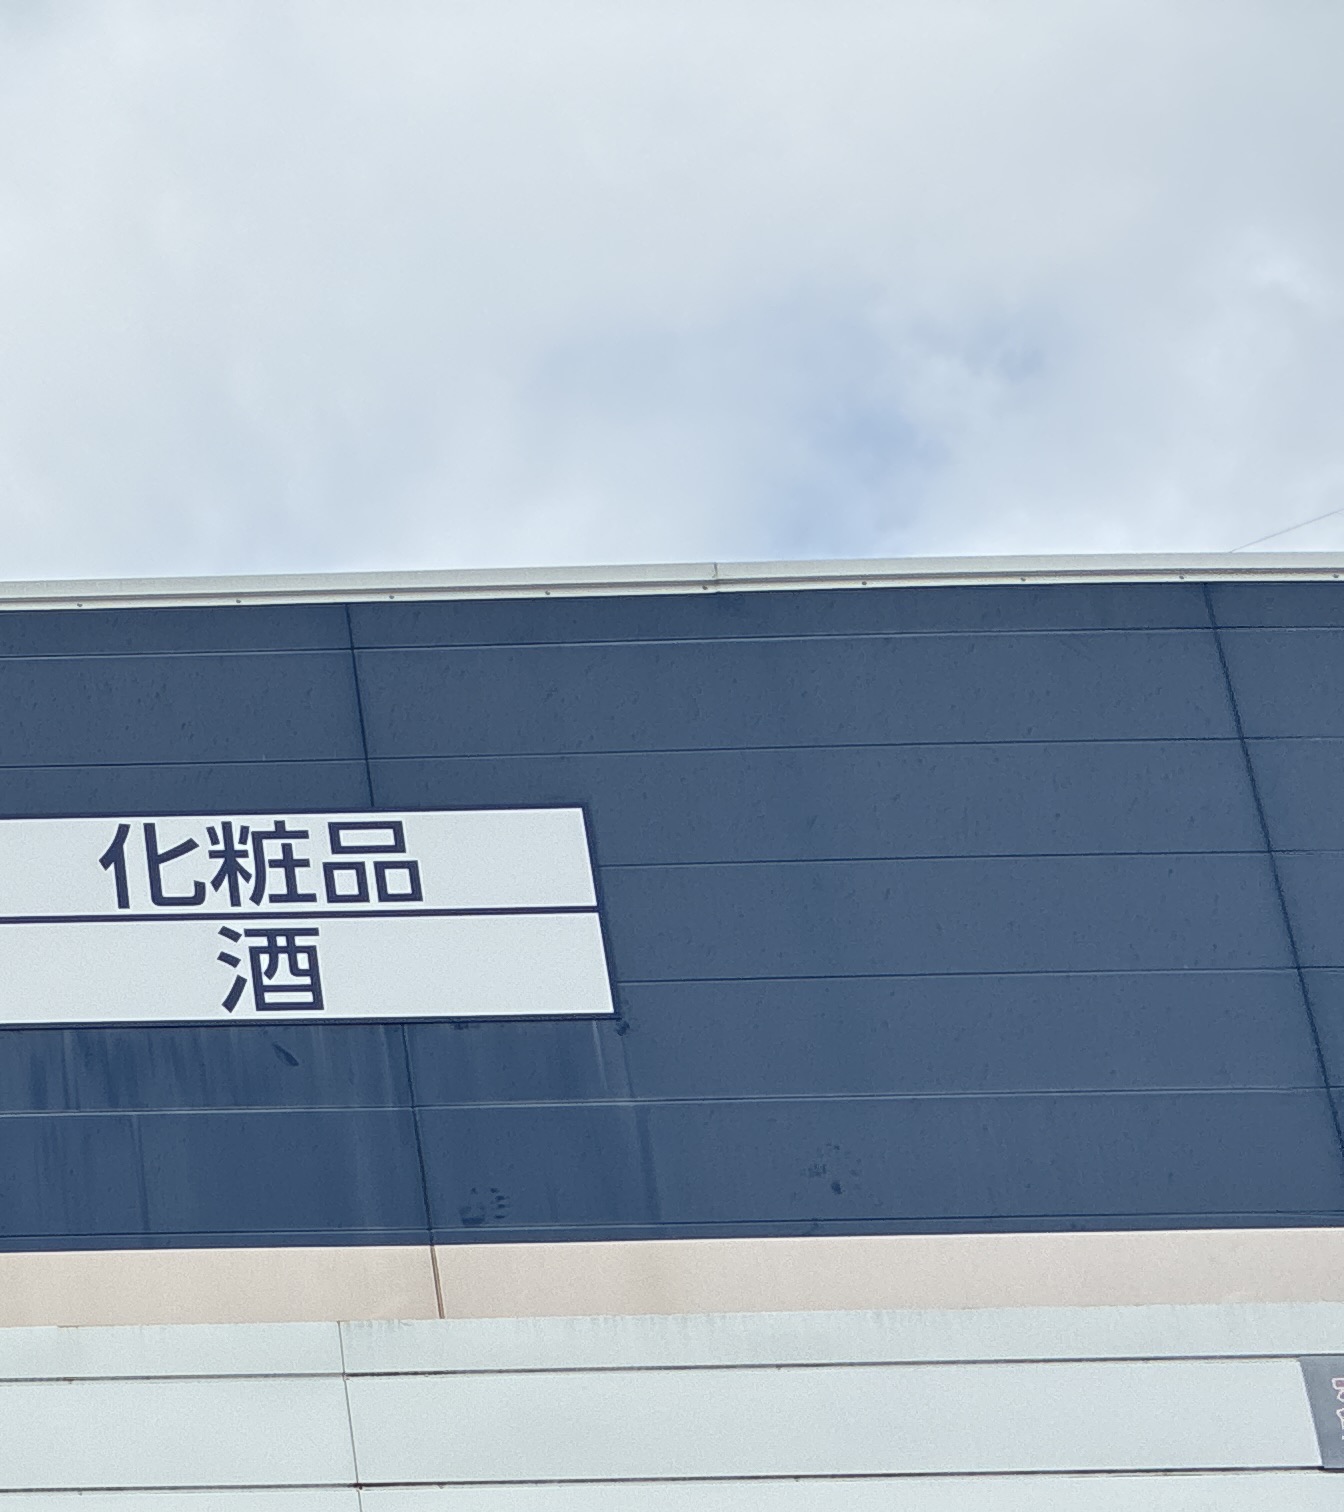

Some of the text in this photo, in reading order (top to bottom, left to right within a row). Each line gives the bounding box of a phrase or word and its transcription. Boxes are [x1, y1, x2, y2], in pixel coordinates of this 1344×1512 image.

[99, 819, 423, 909] 化粧品
[216, 926, 325, 1013] 酒
